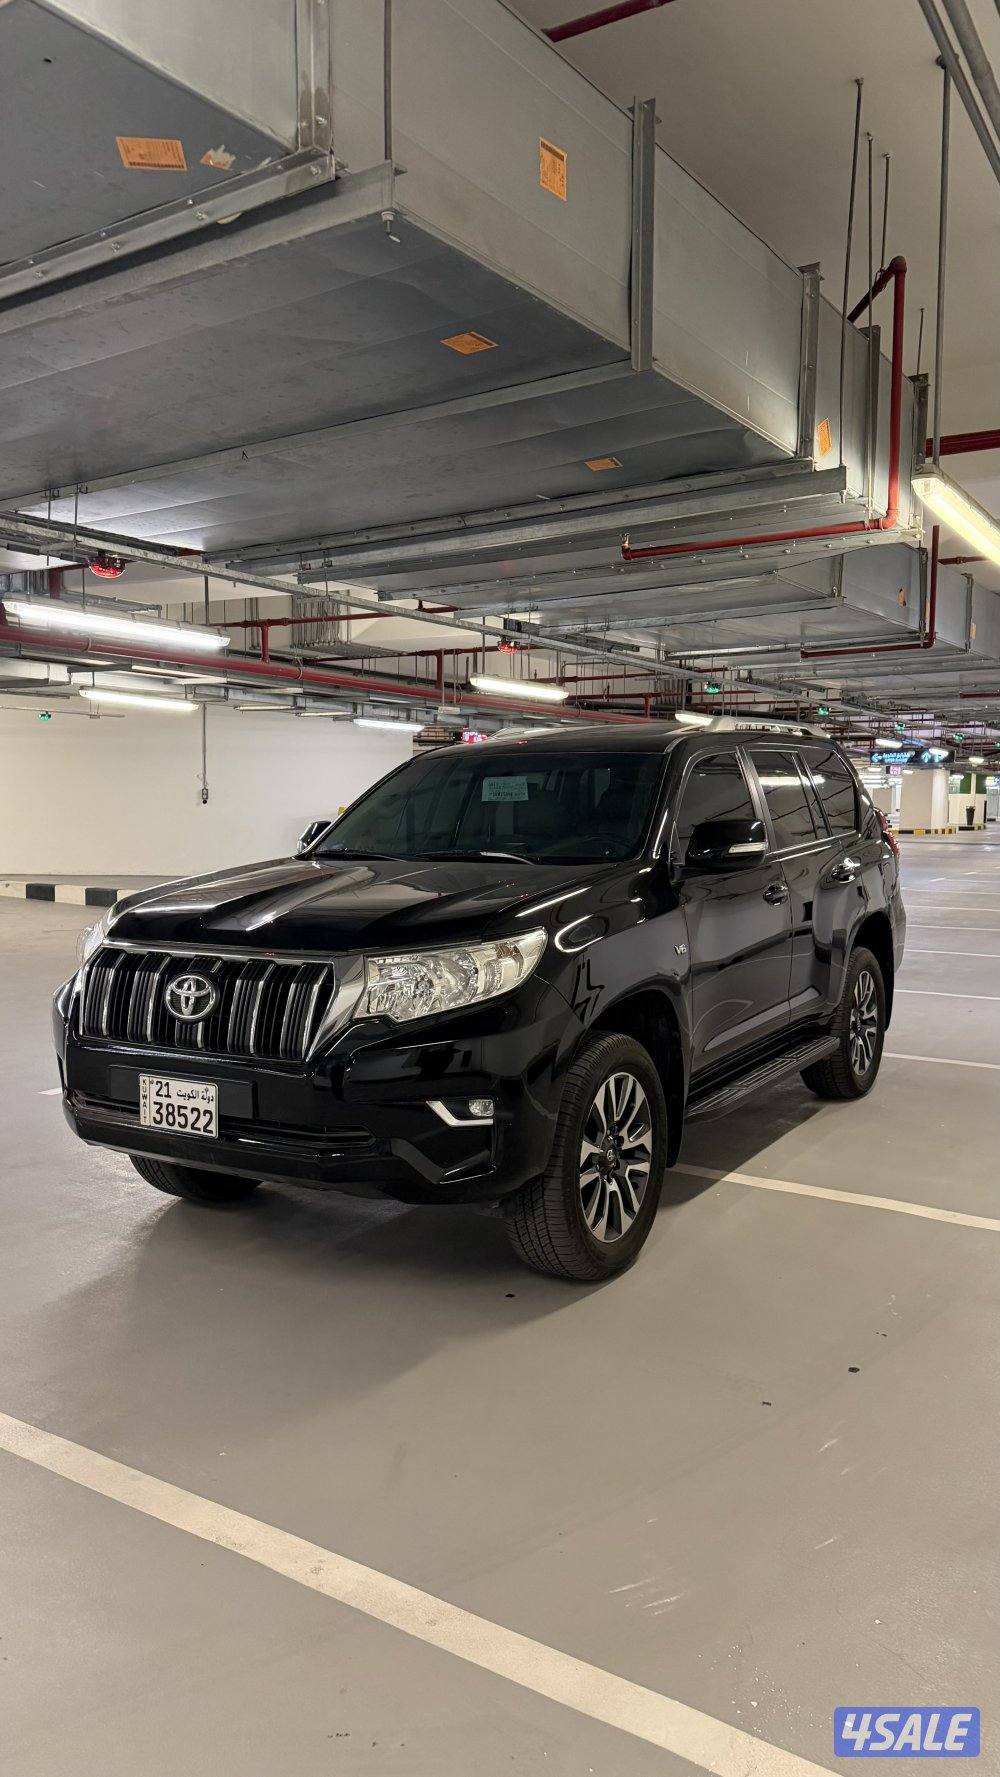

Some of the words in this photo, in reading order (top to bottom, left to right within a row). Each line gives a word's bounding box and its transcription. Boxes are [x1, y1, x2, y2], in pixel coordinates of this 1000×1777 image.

[673, 943, 687, 956] V6
[155, 1080, 172, 1099] 21
[176, 1089, 199, 1101] الكويت
[201, 1091, 214, 1104] دولة
[141, 1079, 149, 1124] KUWAIT
[152, 1101, 214, 1135] 38522
